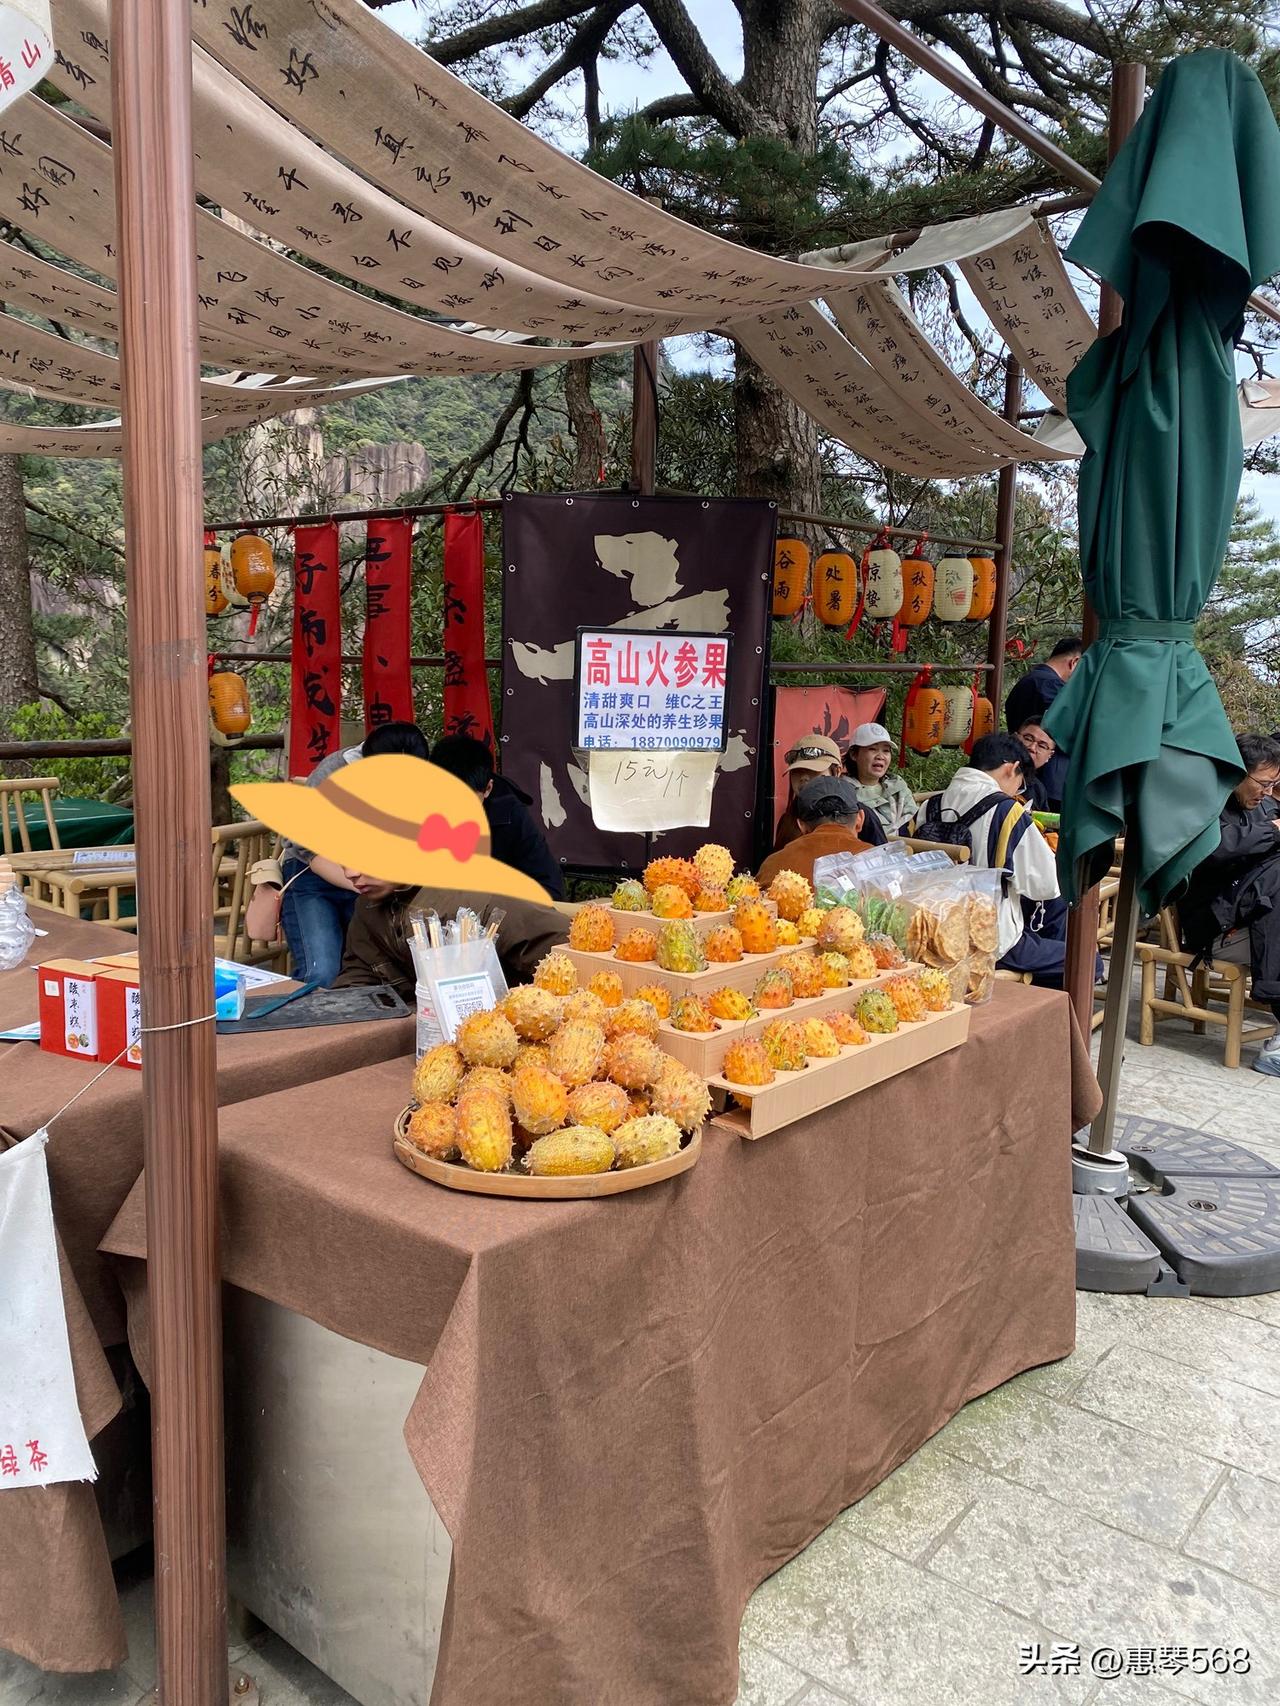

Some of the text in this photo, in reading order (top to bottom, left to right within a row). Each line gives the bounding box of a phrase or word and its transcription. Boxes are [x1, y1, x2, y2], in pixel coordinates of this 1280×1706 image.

[824, 565, 844, 612] 处暑
[911, 570, 928, 613] 秋分
[586, 638, 727, 689] 高山火参果
[583, 692, 723, 711] 清甜爽口 维C之王
[583, 713, 724, 730] 高山深处的养生珍果
[631, 736, 720, 748] 18870090979
